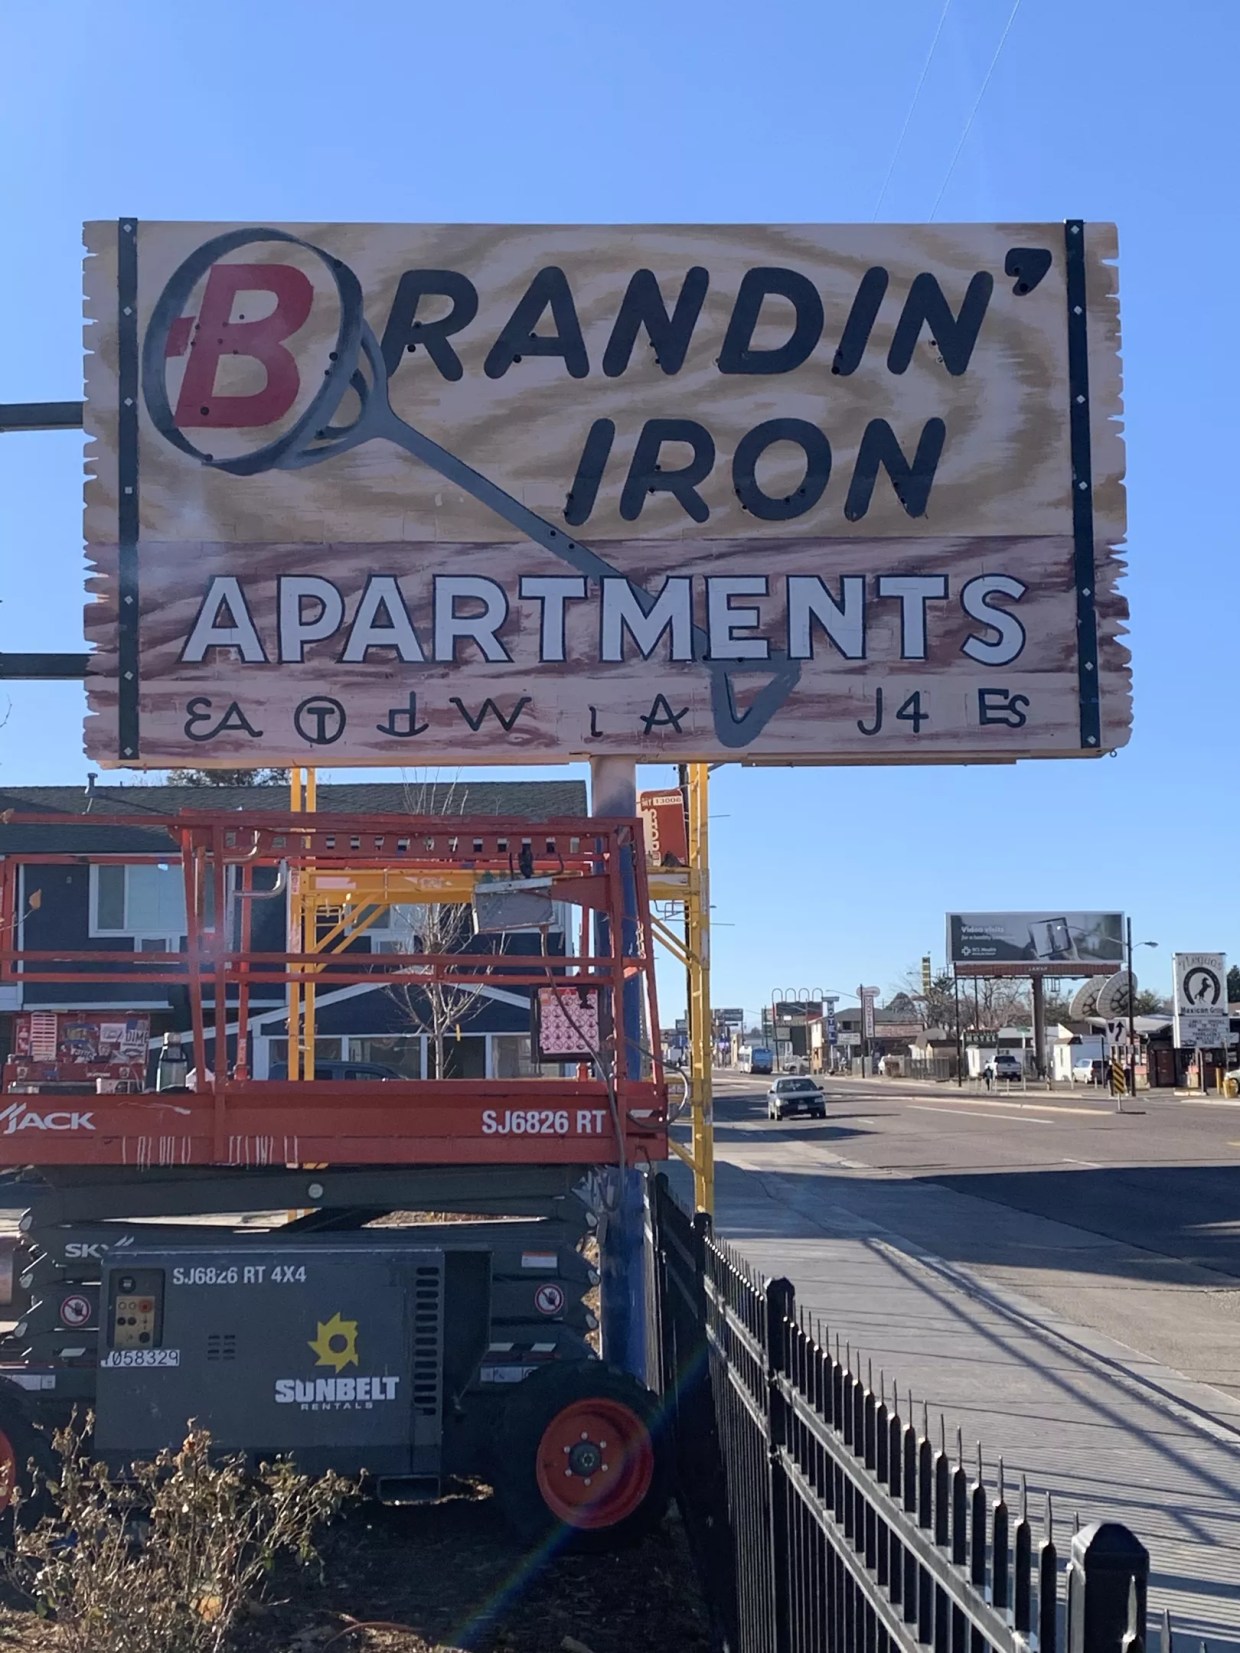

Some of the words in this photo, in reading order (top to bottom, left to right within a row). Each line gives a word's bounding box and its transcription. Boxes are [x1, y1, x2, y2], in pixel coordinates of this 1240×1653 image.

[565, 417, 946, 527] IRON
[176, 573, 1029, 667] APARTMENTS
[827, 1002, 836, 1040] MOTEL
[482, 1110, 569, 1134] SJ6826
[576, 1110, 607, 1133] RT
[173, 1266, 239, 1285] SJ6826
[243, 1266, 267, 1284] RT
[270, 1265, 307, 1283] 4X4
[275, 1376, 400, 1403] SUNBELT
[300, 1401, 373, 1411] RENTALS
